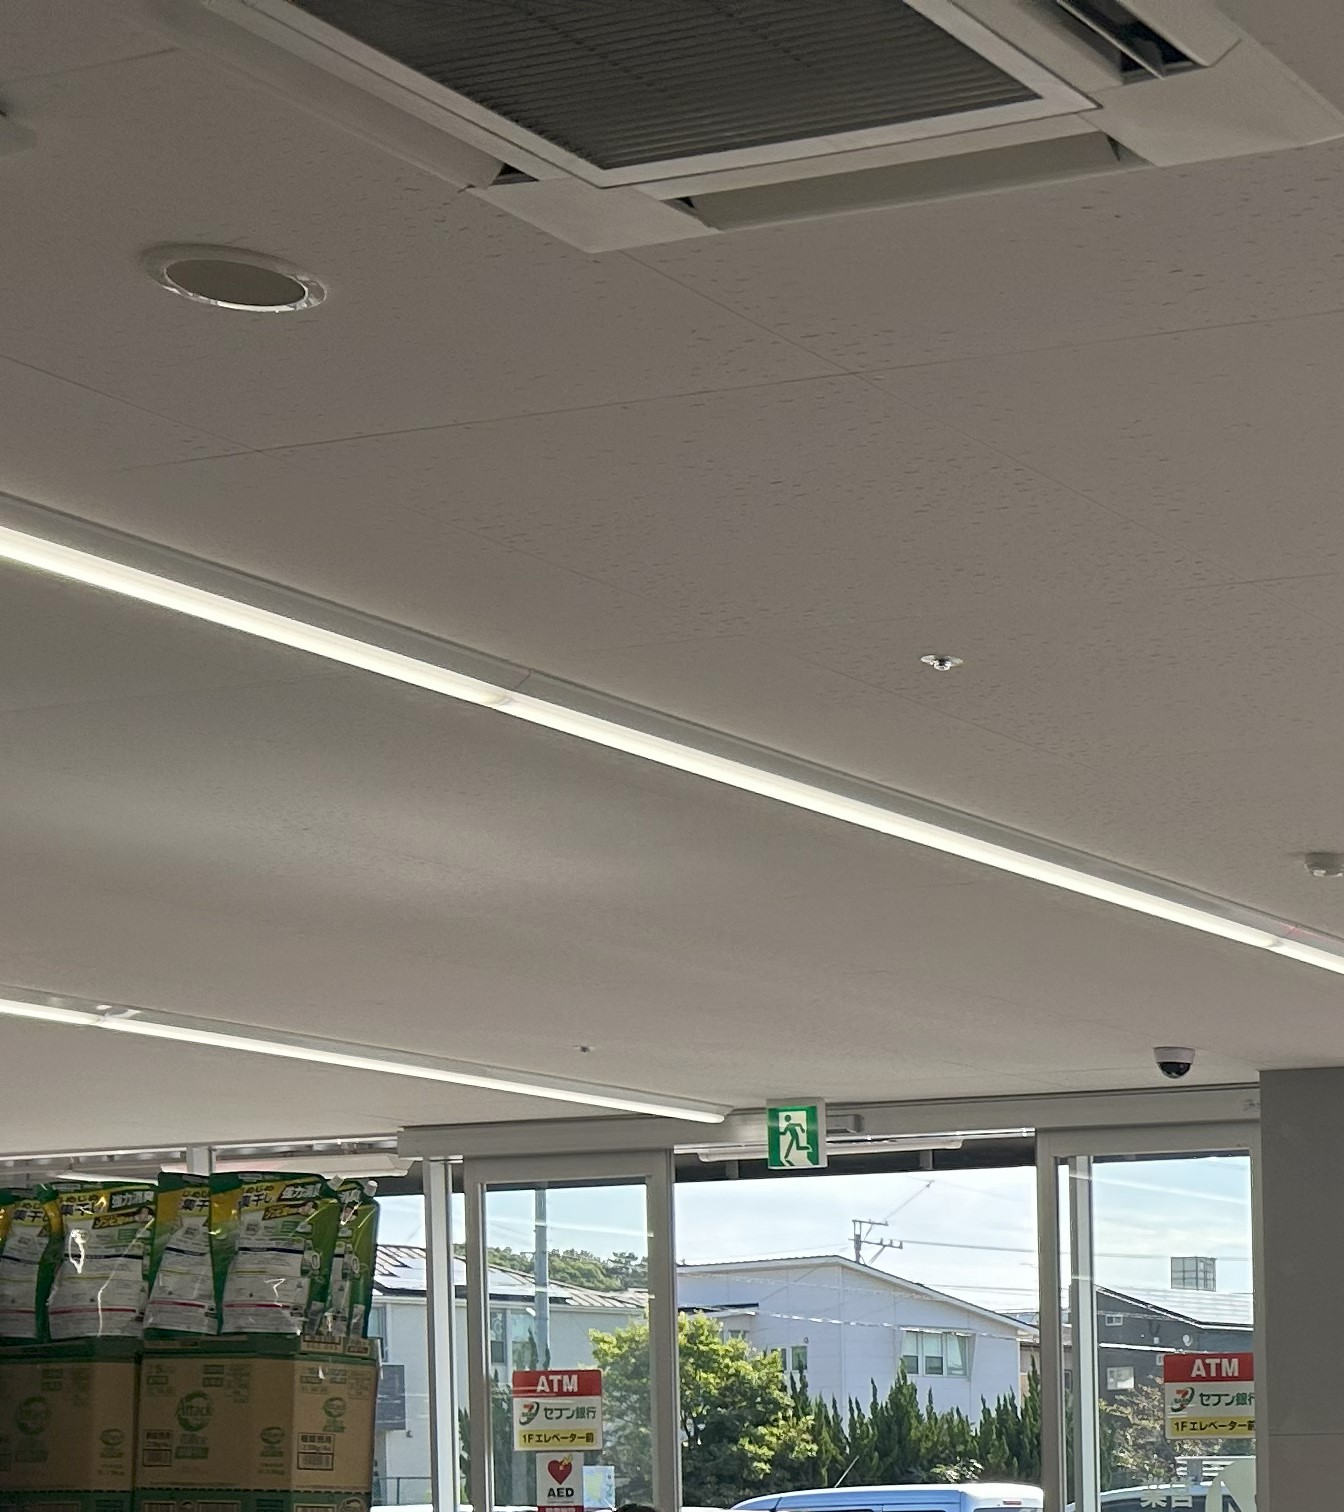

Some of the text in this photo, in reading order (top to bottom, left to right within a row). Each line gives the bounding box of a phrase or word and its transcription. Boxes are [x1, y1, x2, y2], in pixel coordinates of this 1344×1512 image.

[1190, 1358, 1240, 1378] ATM
[536, 1374, 579, 1393] ATM
[543, 1406, 597, 1420] セブン銀行
[522, 1432, 595, 1444] 1Fエレベーター前
[547, 1487, 575, 1498] AED
